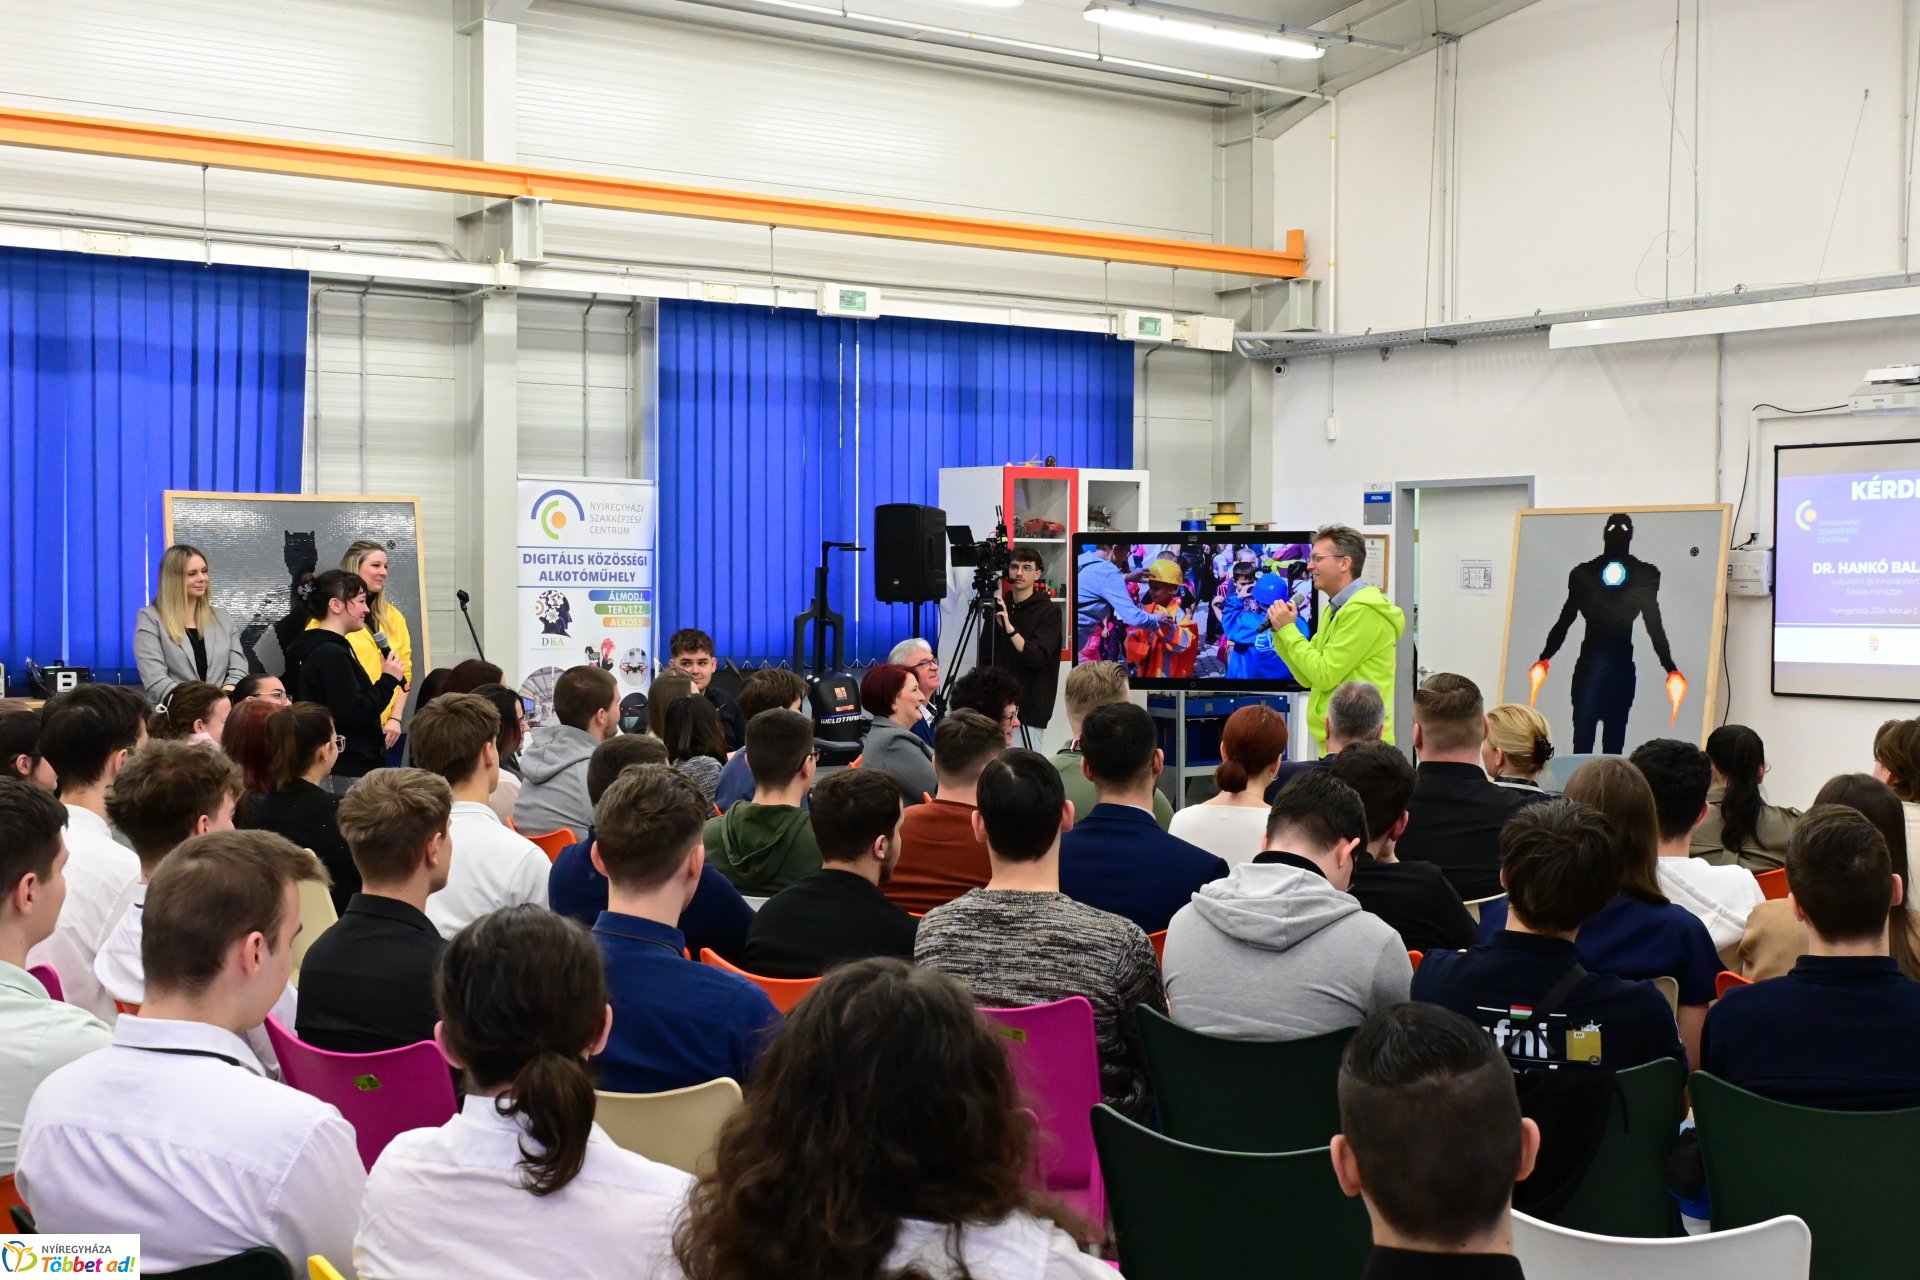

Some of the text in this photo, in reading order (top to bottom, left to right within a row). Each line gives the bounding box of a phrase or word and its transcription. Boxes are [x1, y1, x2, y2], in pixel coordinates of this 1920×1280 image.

[590, 501, 644, 513] NYÍREGYHÁZI
[590, 512, 642, 524] SZAKKÉPZÉSI
[590, 525, 630, 535] CENTRUM
[522, 551, 648, 567] DIGITÁLIS KÖZÖSSÉGI
[1812, 558, 1920, 575] DR. HANKÓ BAL
[538, 568, 636, 582] ALKOTÓMŰHELY
[541, 637, 565, 647] DKA
